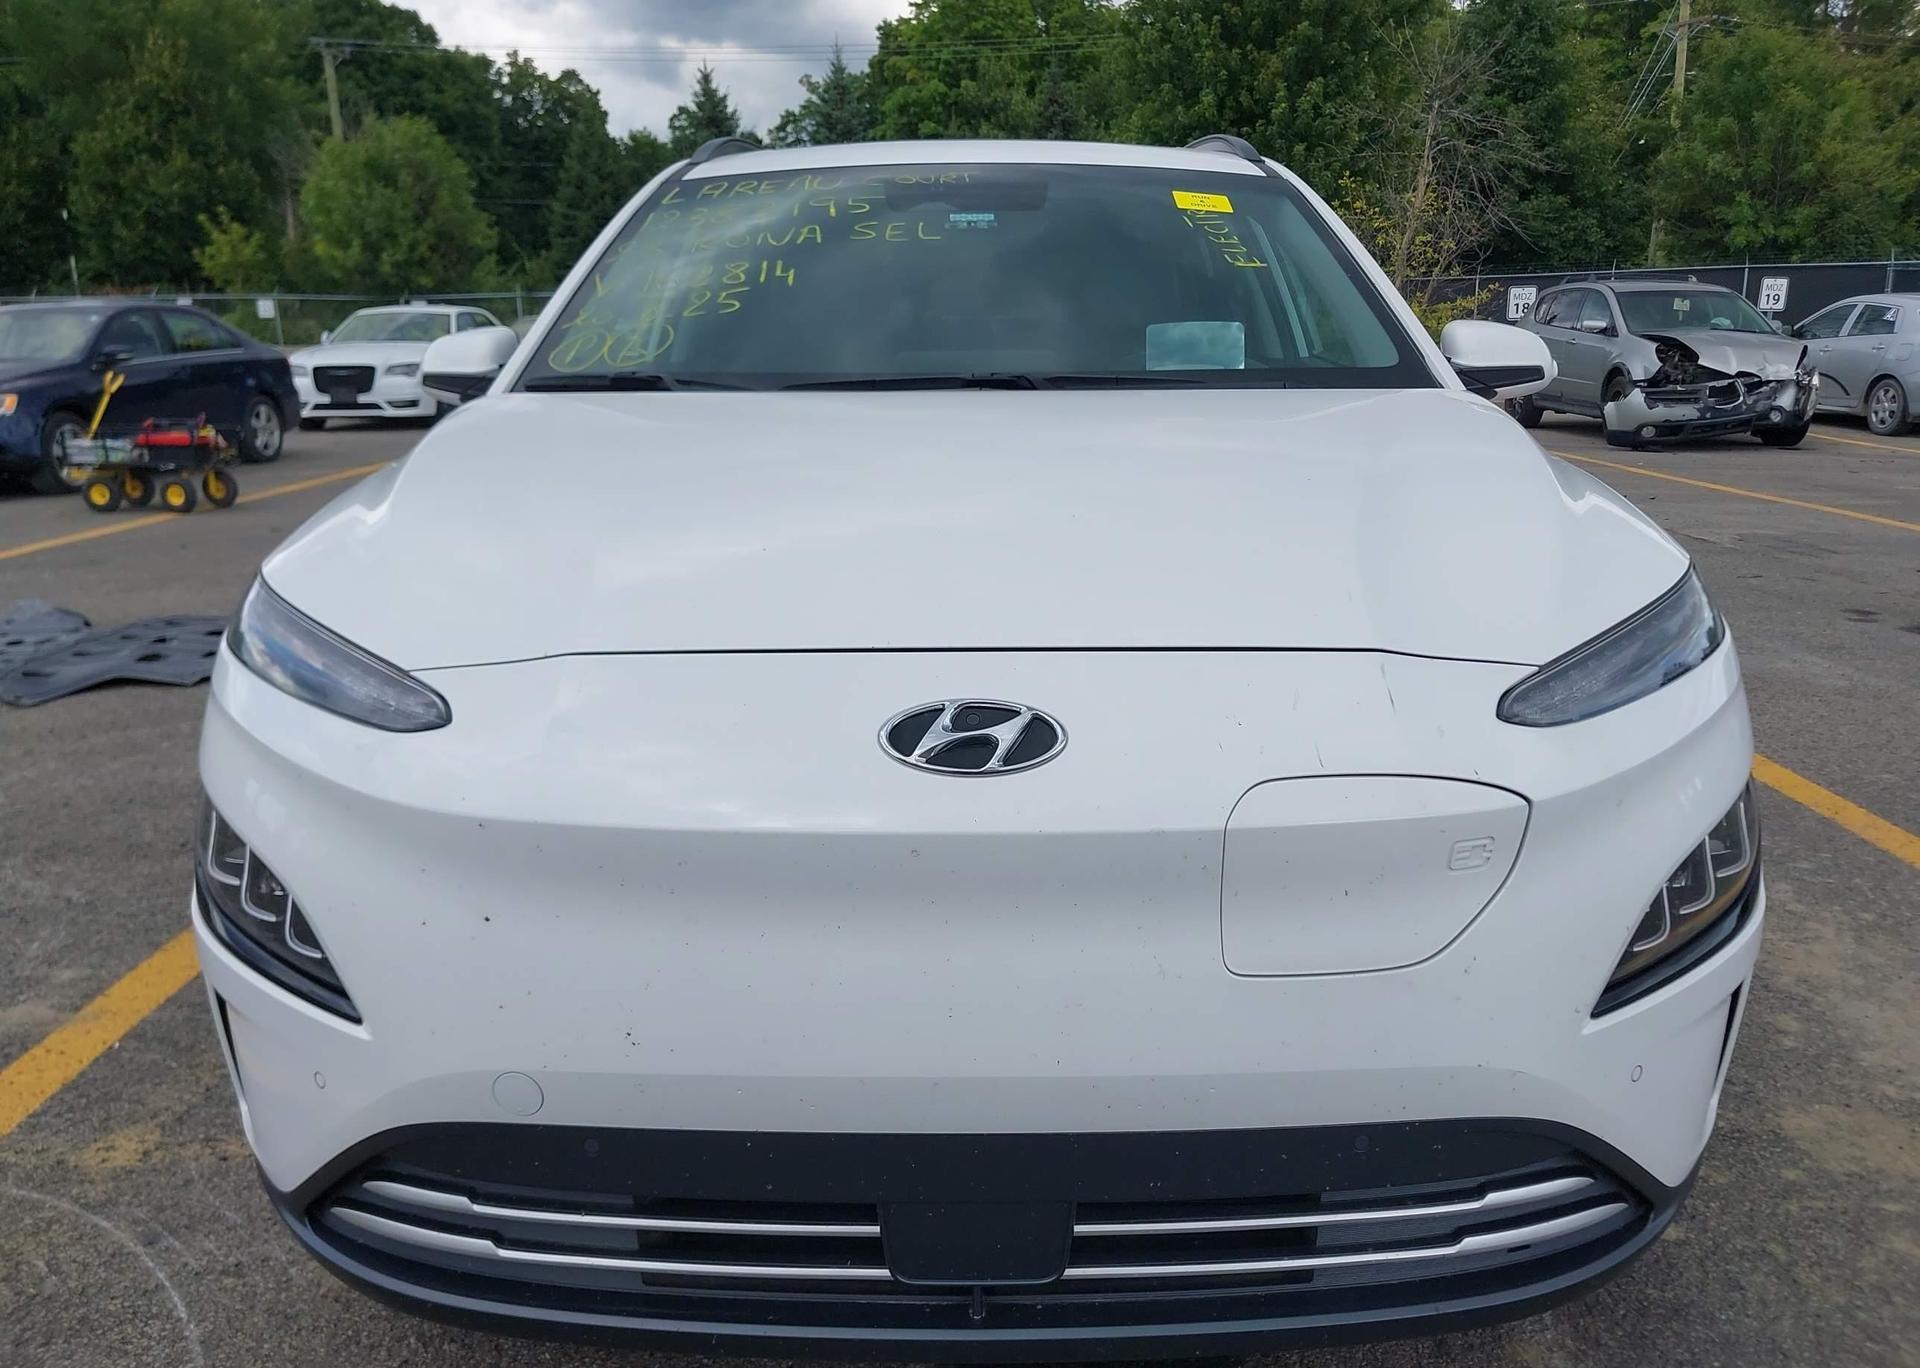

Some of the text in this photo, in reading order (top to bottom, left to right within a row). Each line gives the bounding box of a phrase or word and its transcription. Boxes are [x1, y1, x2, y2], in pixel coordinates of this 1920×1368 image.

[850, 221, 942, 242] SEL
[1765, 284, 1784, 293] MDZ
[1513, 292, 1533, 301] MDZ
[1765, 294, 1780, 305] 19
[1513, 303, 1529, 314] 18
